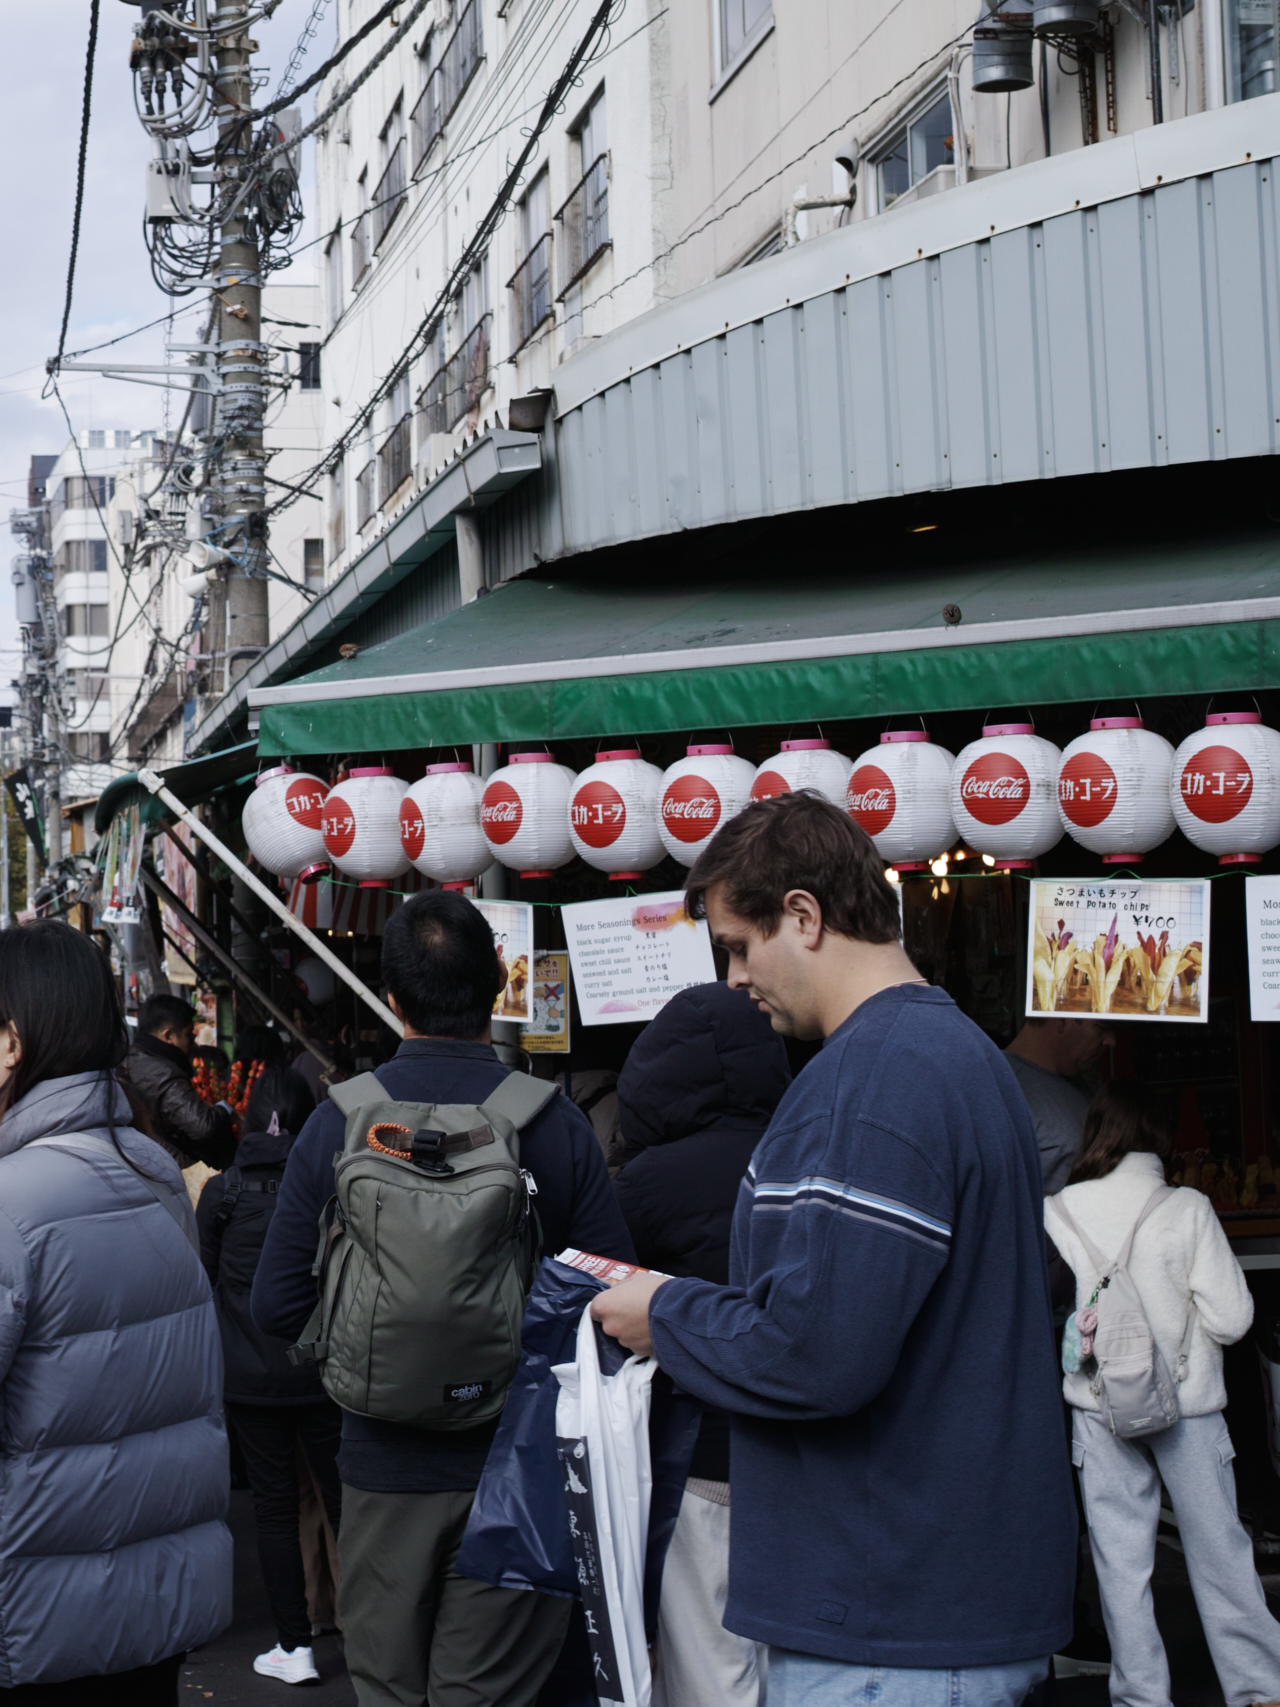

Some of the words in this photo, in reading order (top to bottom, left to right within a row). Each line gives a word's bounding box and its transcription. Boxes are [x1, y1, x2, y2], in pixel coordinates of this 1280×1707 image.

[962, 776, 1027, 798] Coca-Cola
[1181, 771, 1251, 795] コカ・コーラ
[573, 803, 624, 825] コカ・コーラ
[662, 797, 719, 819] Coca-Cola
[1056, 886, 1139, 899] さつまいもチップ
[1053, 898, 1080, 908] Sweet
[1124, 902, 1150, 911] chips
[576, 923, 595, 932] More
[597, 917, 641, 930] Seasonings
[643, 914, 667, 924] Series
[1132, 914, 1177, 929] ¥700
[576, 938, 592, 946] black
[594, 936, 611, 944] sugar
[613, 934, 632, 943] syrup
[578, 948, 605, 957] chocolate
[598, 957, 612, 966] chili
[582, 969, 607, 978] seaweed
[608, 968, 620, 976] and
[621, 967, 632, 975] salt
[584, 981, 600, 989] curry
[586, 990, 610, 999] Coarsely
[612, 988, 634, 998] ground
[648, 985, 661, 993] and
[662, 983, 684, 992] pepper
[637, 999, 651, 1007] One
[451, 1384, 483, 1397] cabin
[458, 1391, 480, 1402] zero
